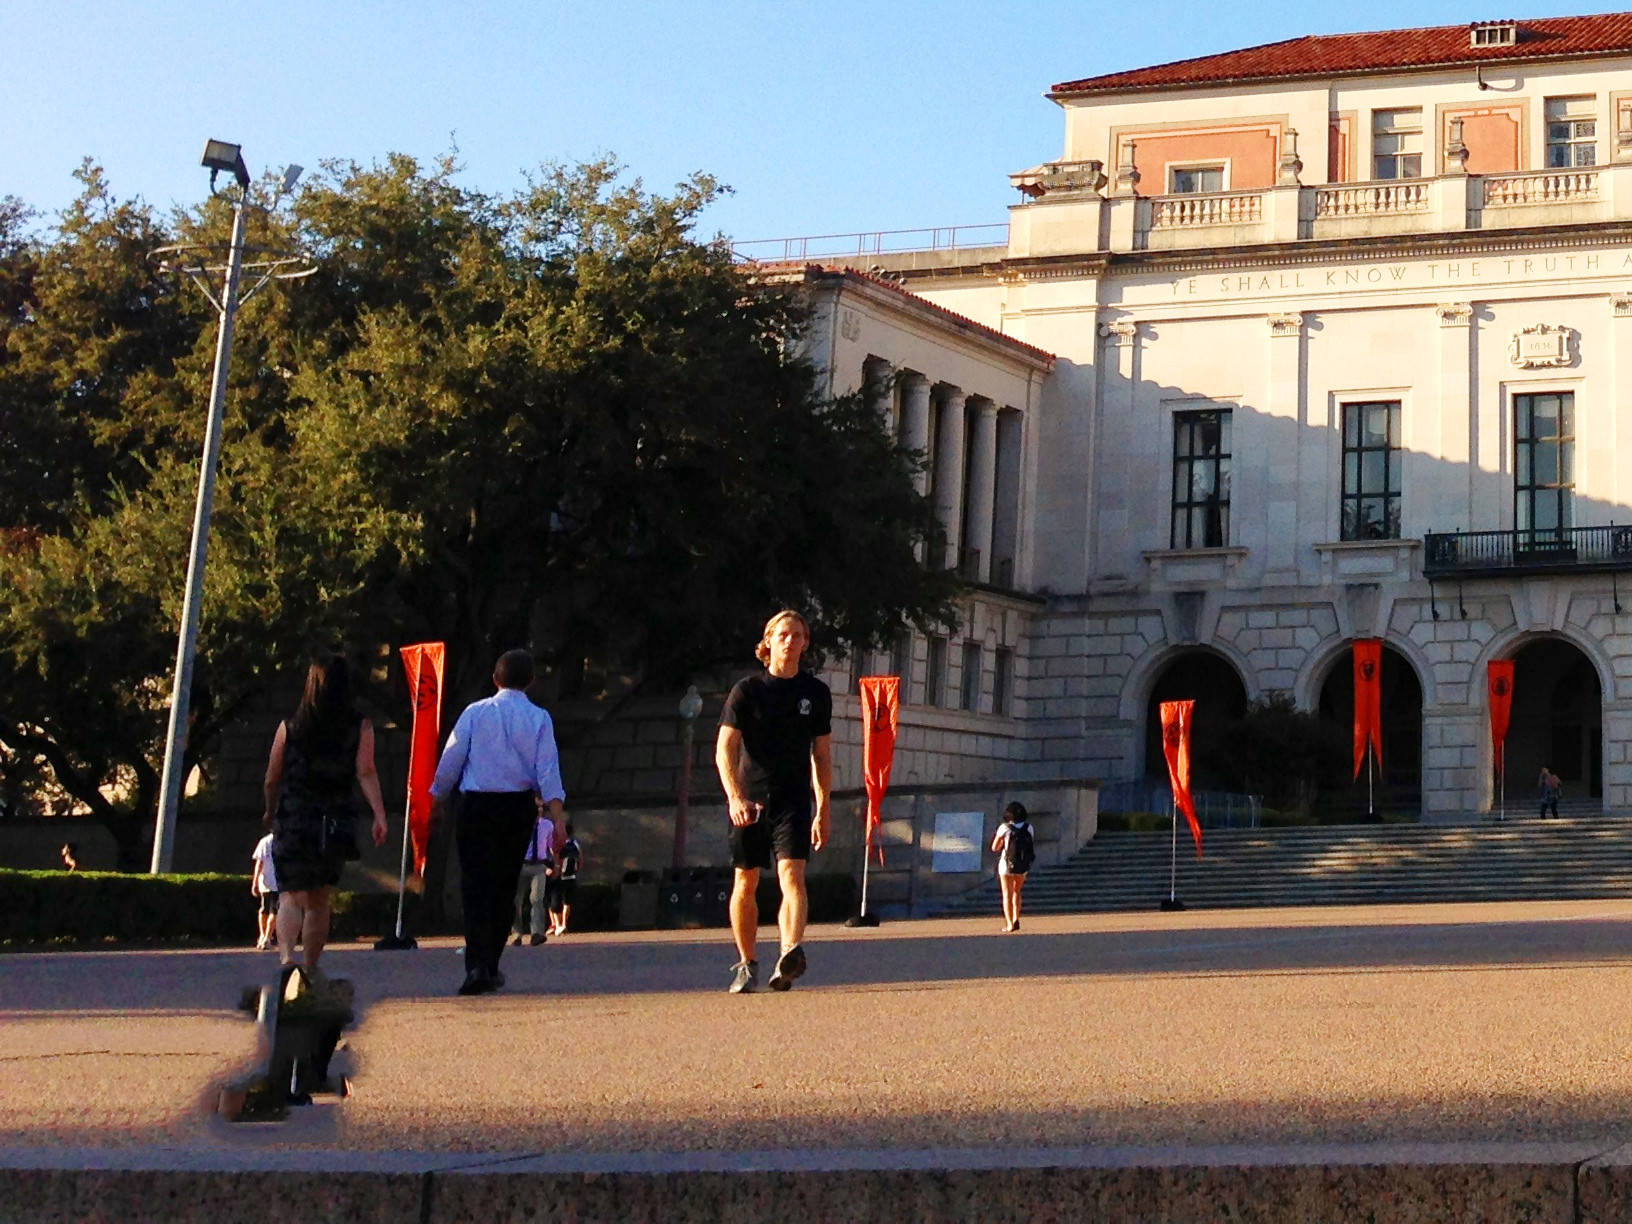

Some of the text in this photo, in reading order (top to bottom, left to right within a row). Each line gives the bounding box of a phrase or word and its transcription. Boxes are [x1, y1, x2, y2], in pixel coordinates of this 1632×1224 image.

[1170, 280, 1198, 296] YE
[1220, 272, 1305, 292] SHALL
[1326, 266, 1406, 286] KNOW
[1428, 262, 1481, 279] THE
[1503, 255, 1600, 274] TRUTH
